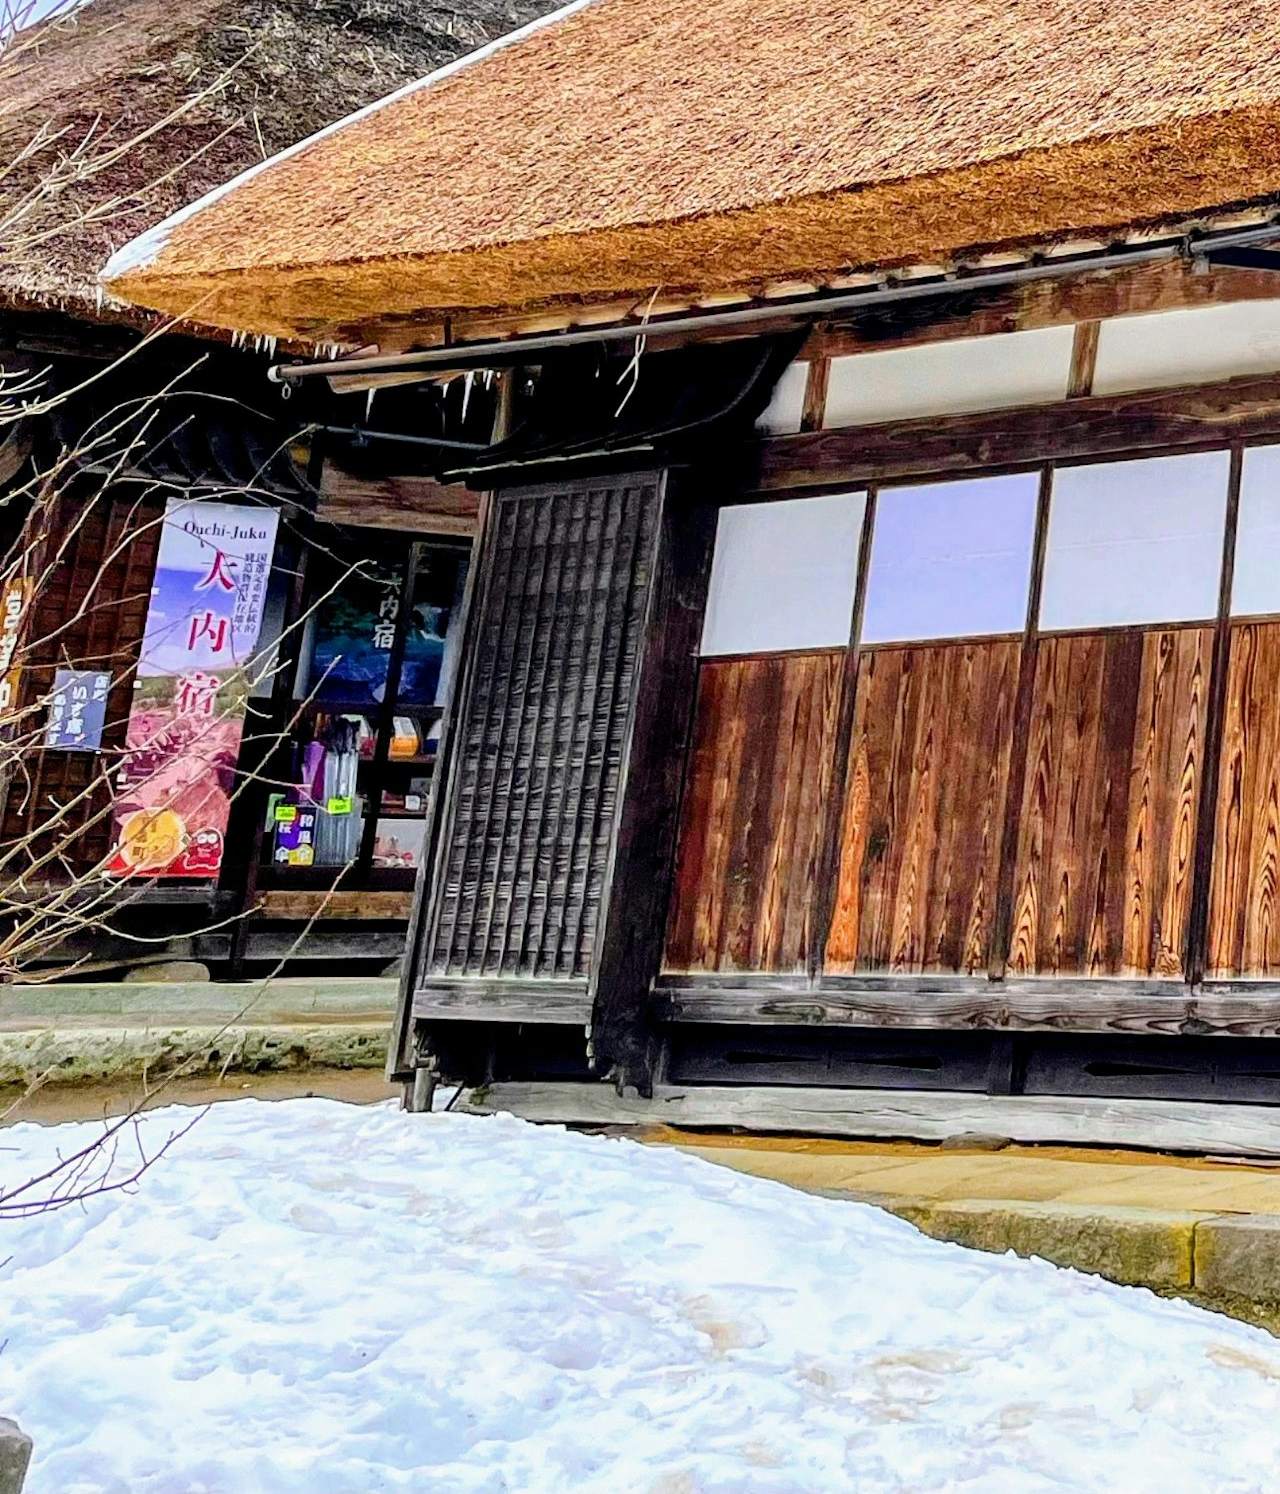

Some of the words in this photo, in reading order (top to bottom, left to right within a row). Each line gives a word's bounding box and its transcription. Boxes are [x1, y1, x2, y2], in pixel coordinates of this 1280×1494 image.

[184, 521, 267, 539] Ouchi-Juku
[176, 550, 238, 714] 大内宿
[372, 572, 402, 648] 大内宿
